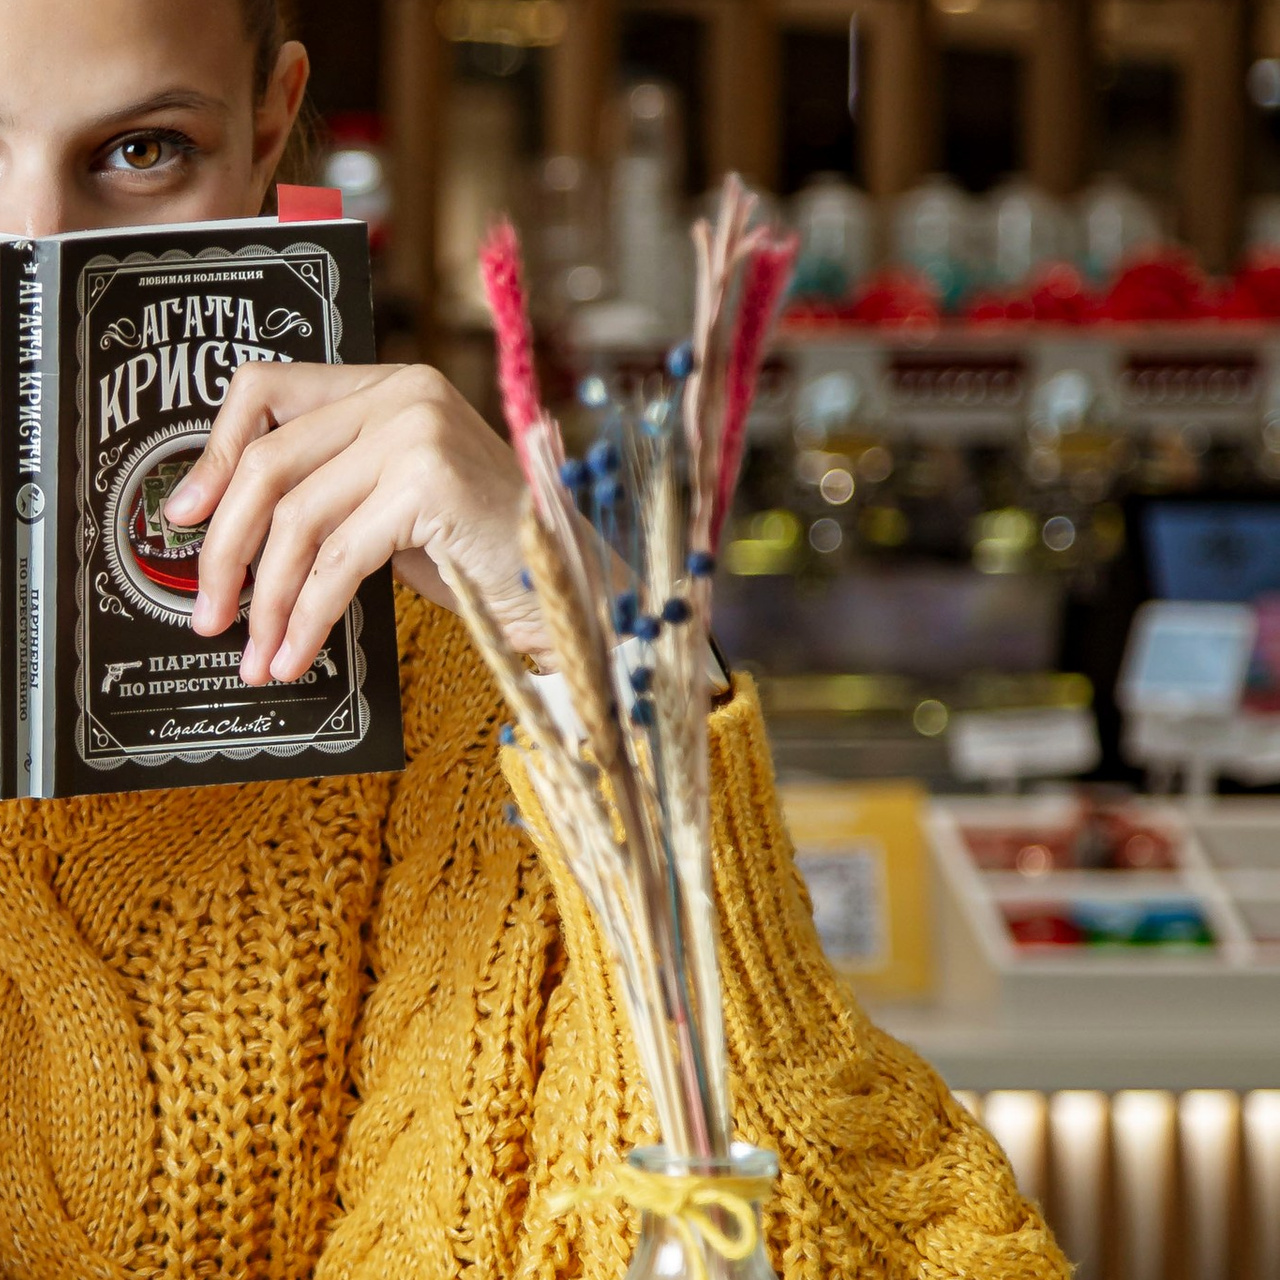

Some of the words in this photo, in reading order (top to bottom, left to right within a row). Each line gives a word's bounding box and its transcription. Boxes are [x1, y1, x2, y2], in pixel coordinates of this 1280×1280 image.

[138, 273, 191, 287] ЛЮБИМАЯ
[193, 270, 265, 283] КОЛЛЕКЦИЯ
[19, 280, 43, 364] АГАТА
[141, 295, 259, 350] АГАТА
[19, 371, 43, 473] КРИСТИ
[99, 340, 294, 444] КРИС
[30, 589, 40, 689] ПАРТНЕРЫ
[148, 651, 242, 672] ПАРТНЕ
[119, 681, 146, 697] ПО
[148, 670, 318, 695] ПРЕСТУПЮ
